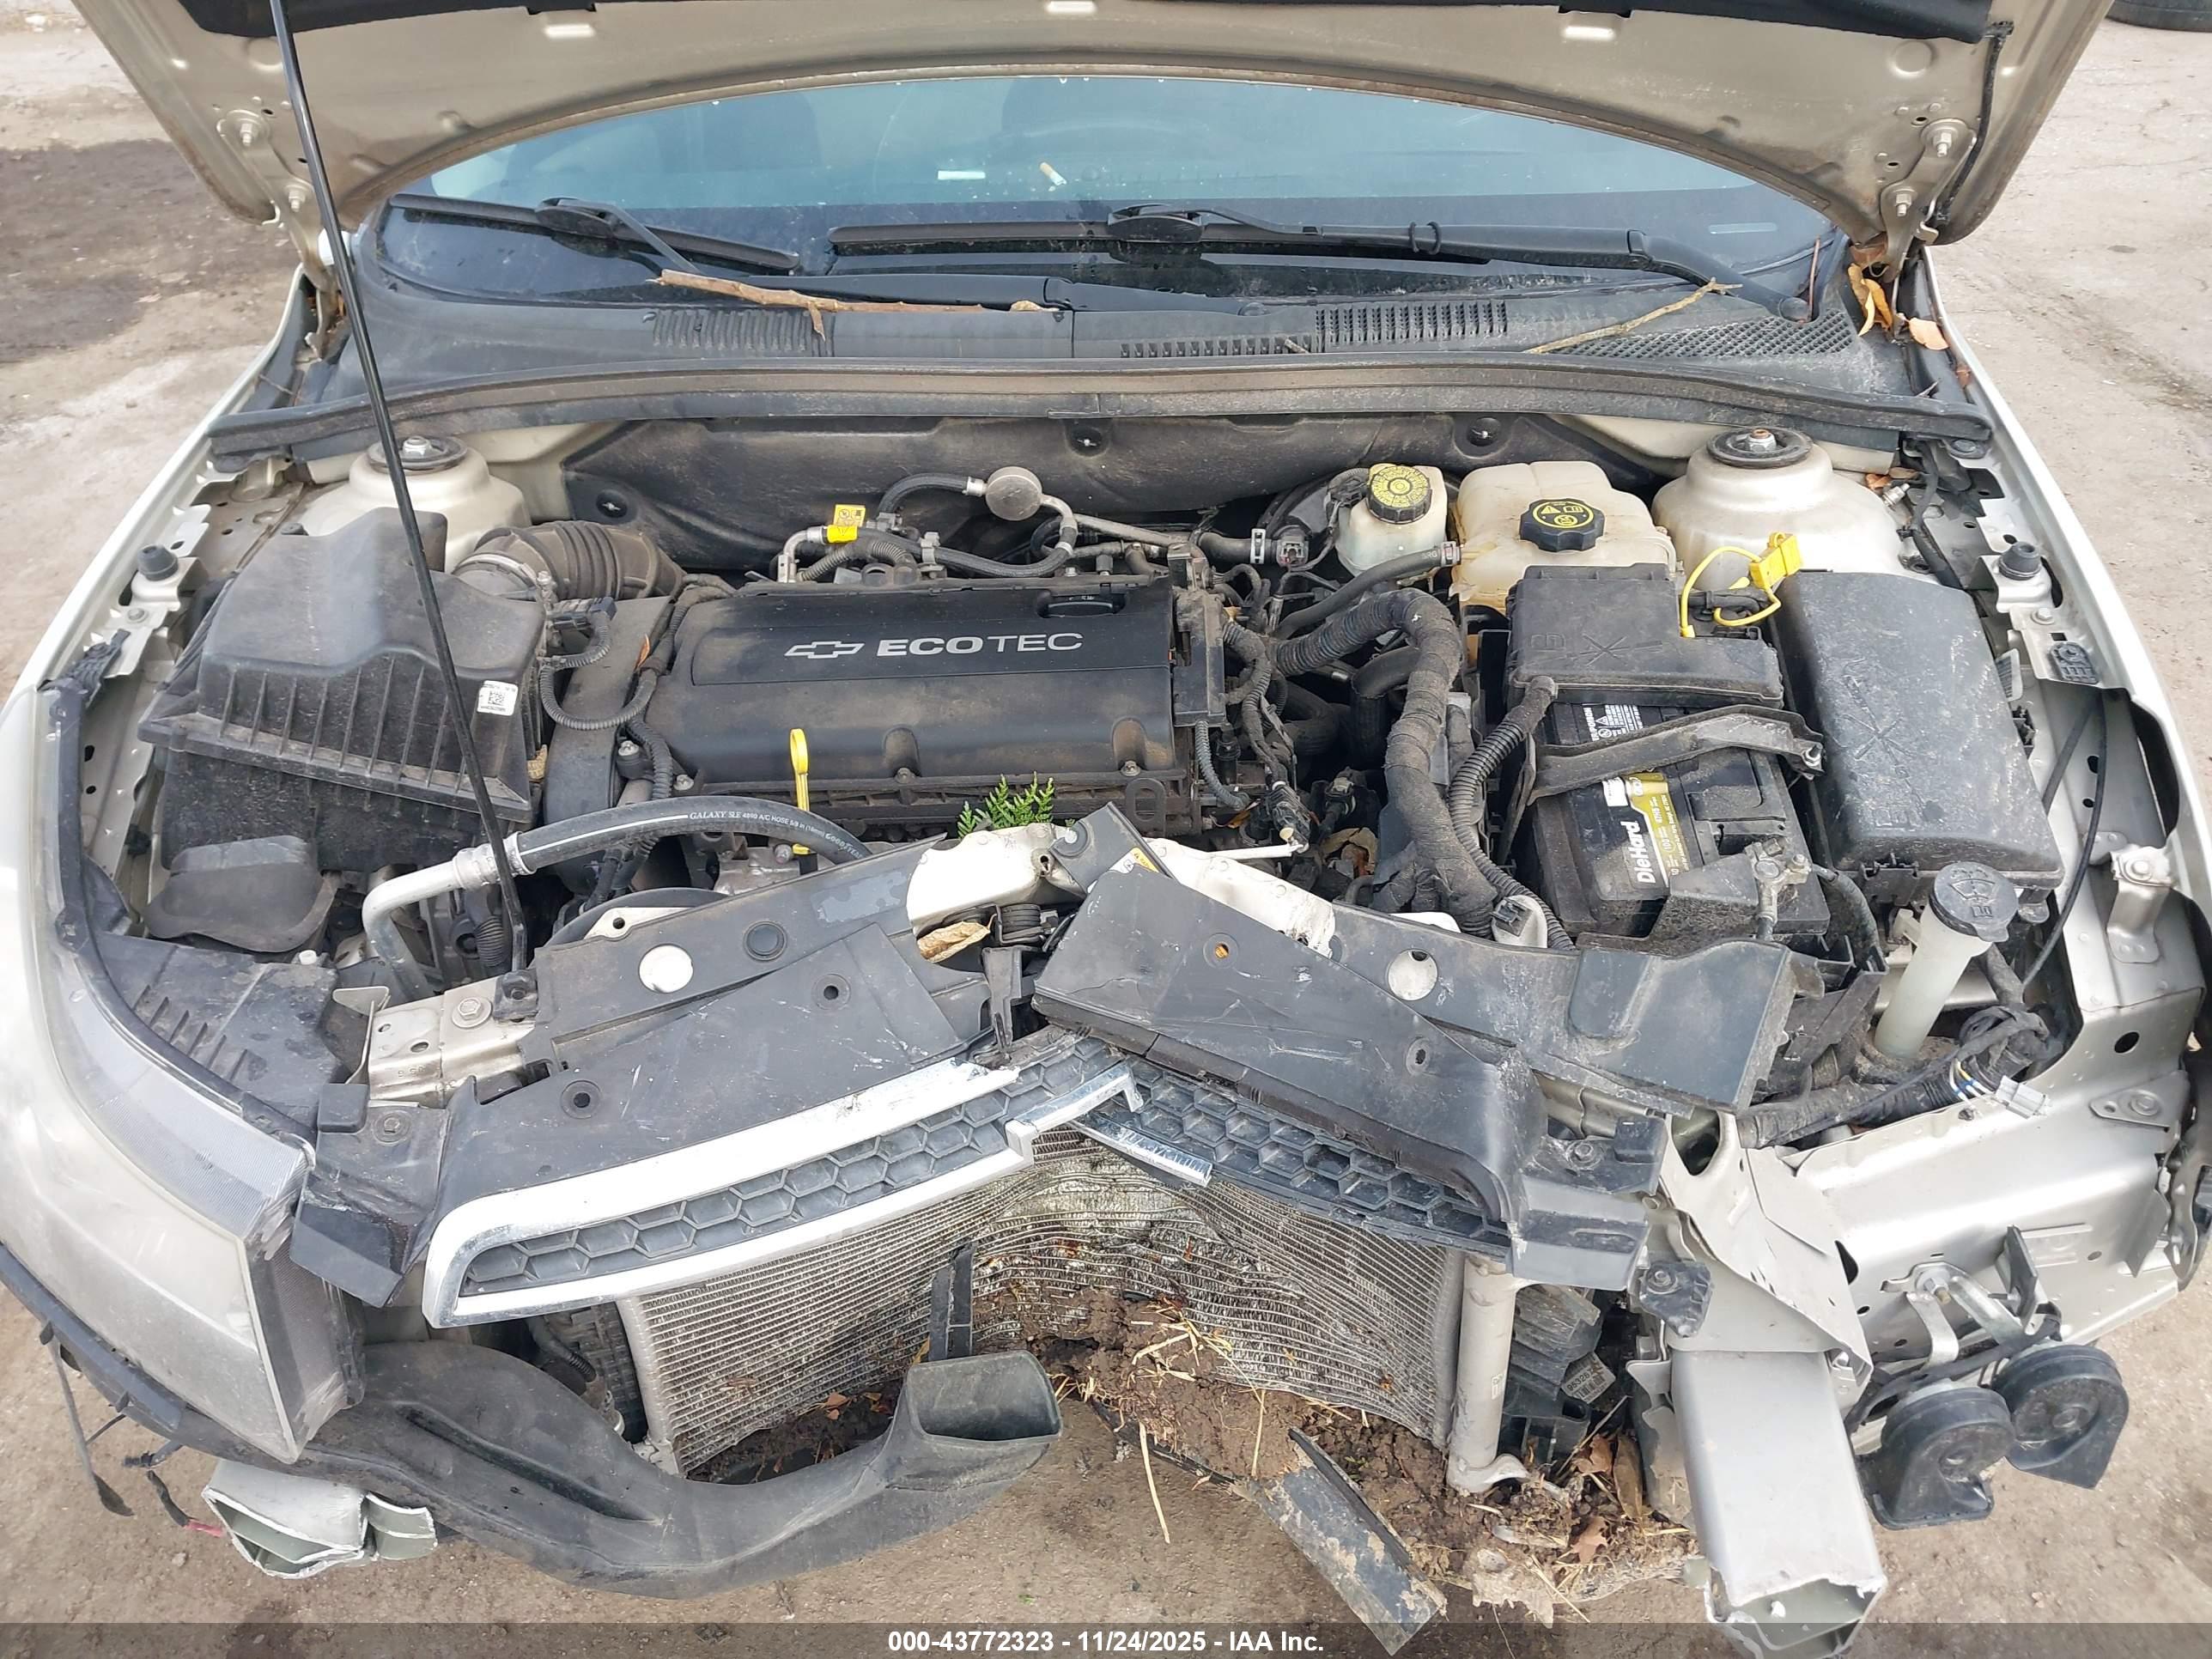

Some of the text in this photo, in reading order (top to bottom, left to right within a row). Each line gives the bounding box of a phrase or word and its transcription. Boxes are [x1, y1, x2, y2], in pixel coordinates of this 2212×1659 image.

[876, 633, 1084, 658] ECOTEC
[690, 811, 726, 820] GALAXY
[770, 815, 790, 825] HOSE
[1620, 820, 1656, 884] DieHard
